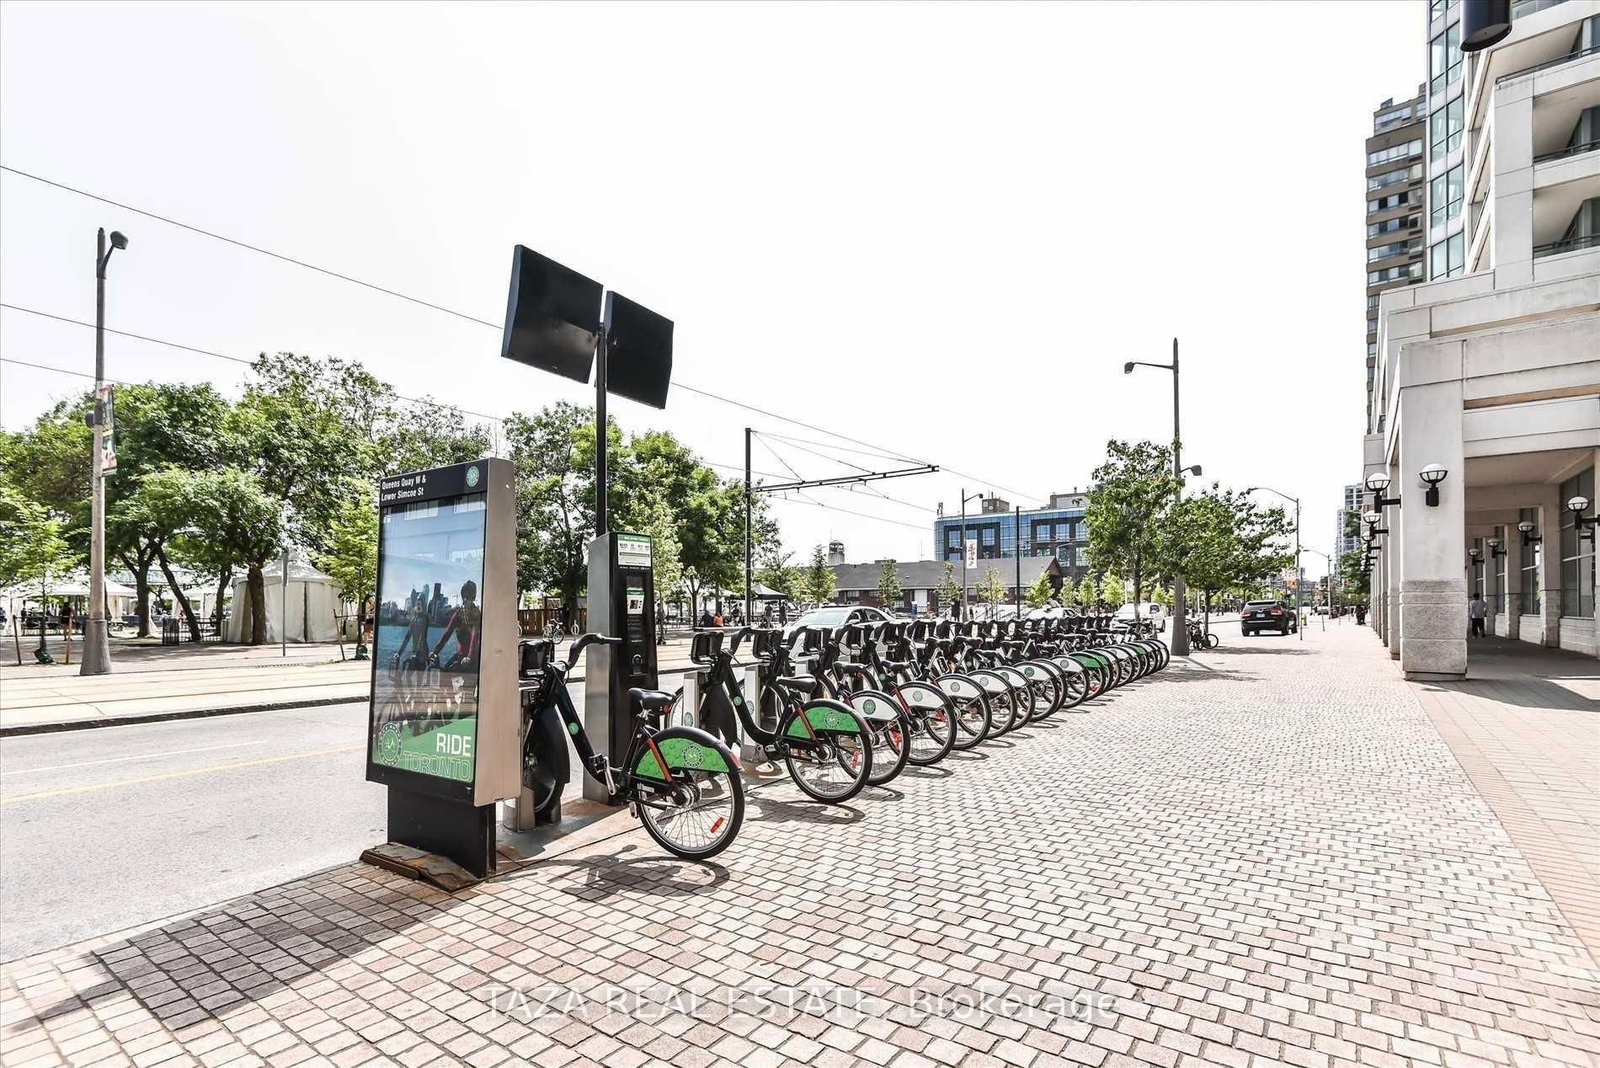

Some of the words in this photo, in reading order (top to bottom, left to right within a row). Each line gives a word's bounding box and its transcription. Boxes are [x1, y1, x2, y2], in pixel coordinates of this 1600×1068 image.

[381, 493, 396, 501] Lower
[397, 490, 416, 499] Simcoe
[417, 486, 424, 496] St
[382, 481, 400, 490] Queens
[401, 478, 414, 487] Quay
[436, 733, 471, 756] RIDE
[403, 752, 471, 781] TORONTO
